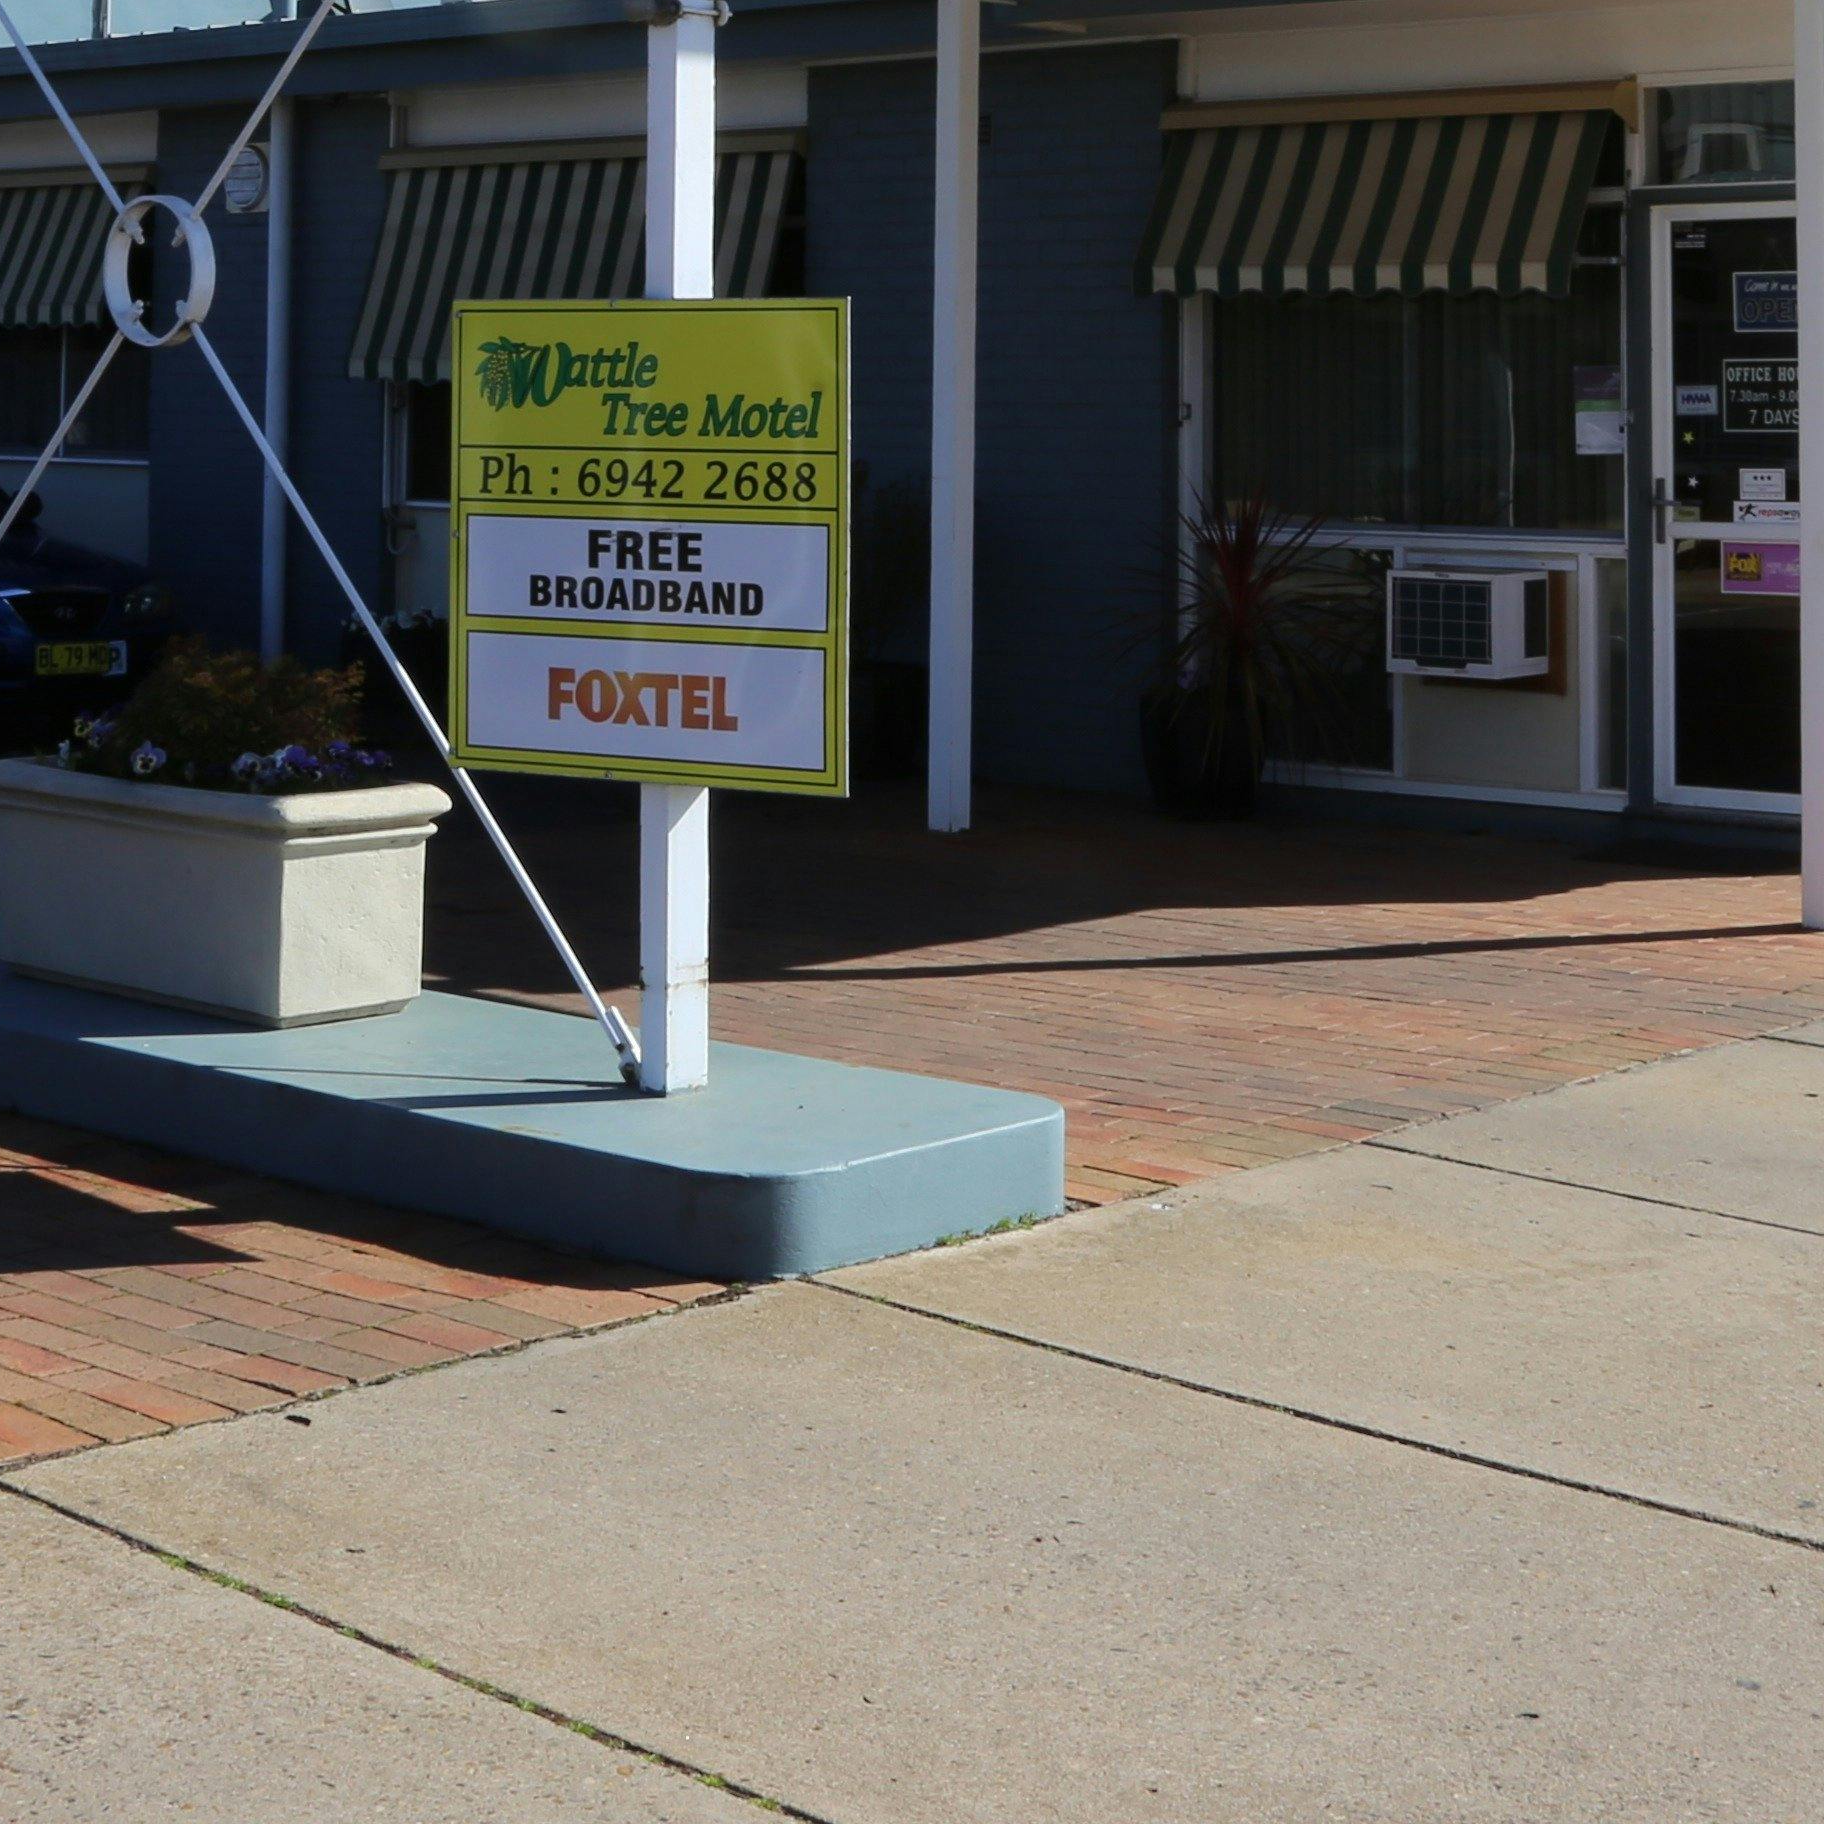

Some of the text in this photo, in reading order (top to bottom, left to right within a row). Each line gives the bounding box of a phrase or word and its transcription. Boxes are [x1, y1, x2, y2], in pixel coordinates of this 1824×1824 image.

[510, 341, 658, 409] Wattle
[1727, 366, 1799, 382] OFFICE HO
[601, 391, 822, 439] Tree Motel
[1749, 410, 1759, 426] 7
[479, 454, 533, 496] Ph
[578, 458, 685, 499] 6942
[704, 461, 817, 503] 2688
[587, 529, 703, 573] FREE
[530, 574, 764, 616] BROADBAND
[547, 666, 739, 732] FOXTEL
